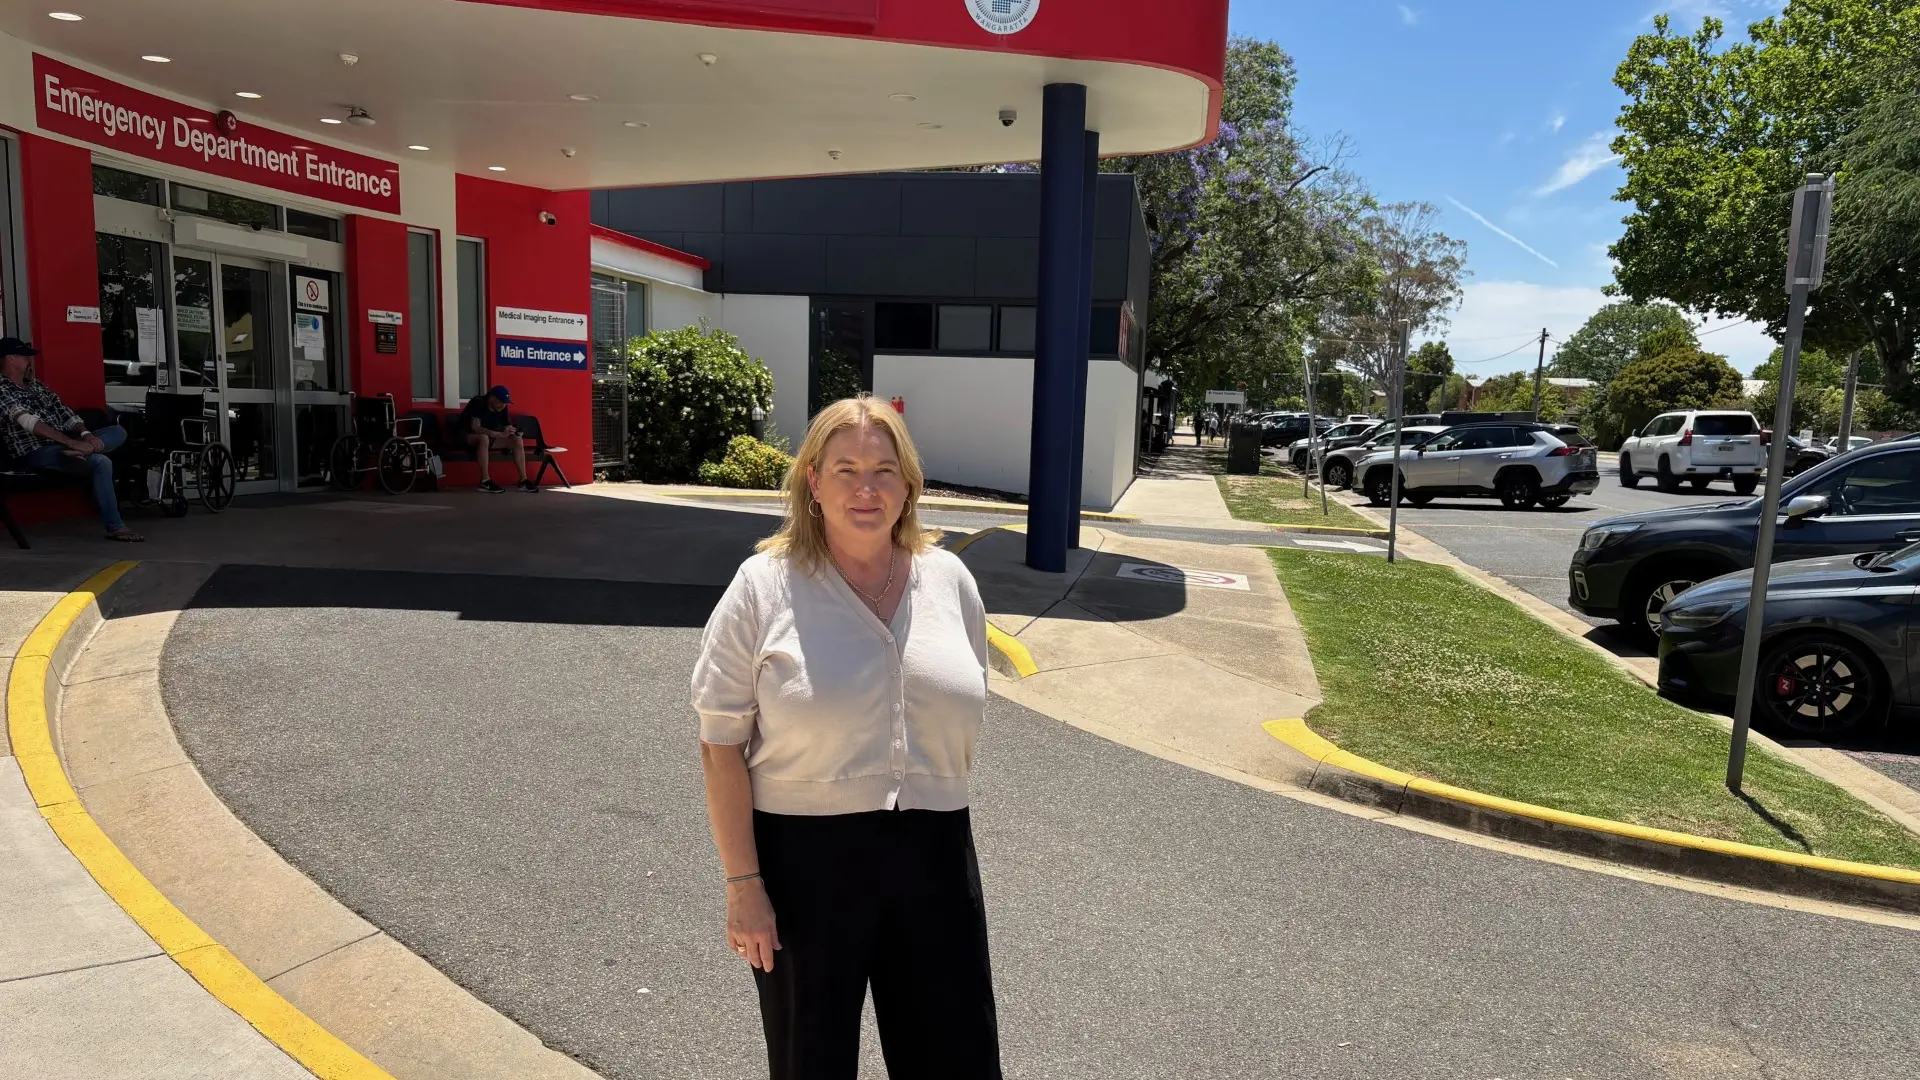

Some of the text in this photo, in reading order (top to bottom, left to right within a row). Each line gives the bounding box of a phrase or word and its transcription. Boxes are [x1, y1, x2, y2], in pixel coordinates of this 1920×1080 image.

[975, 13, 1028, 32] WANGARATTA
[44, 73, 392, 198] Emergency Department Entrance
[498, 311, 575, 325] Medical Imaging Entrance
[500, 345, 571, 362] Main Entrance
